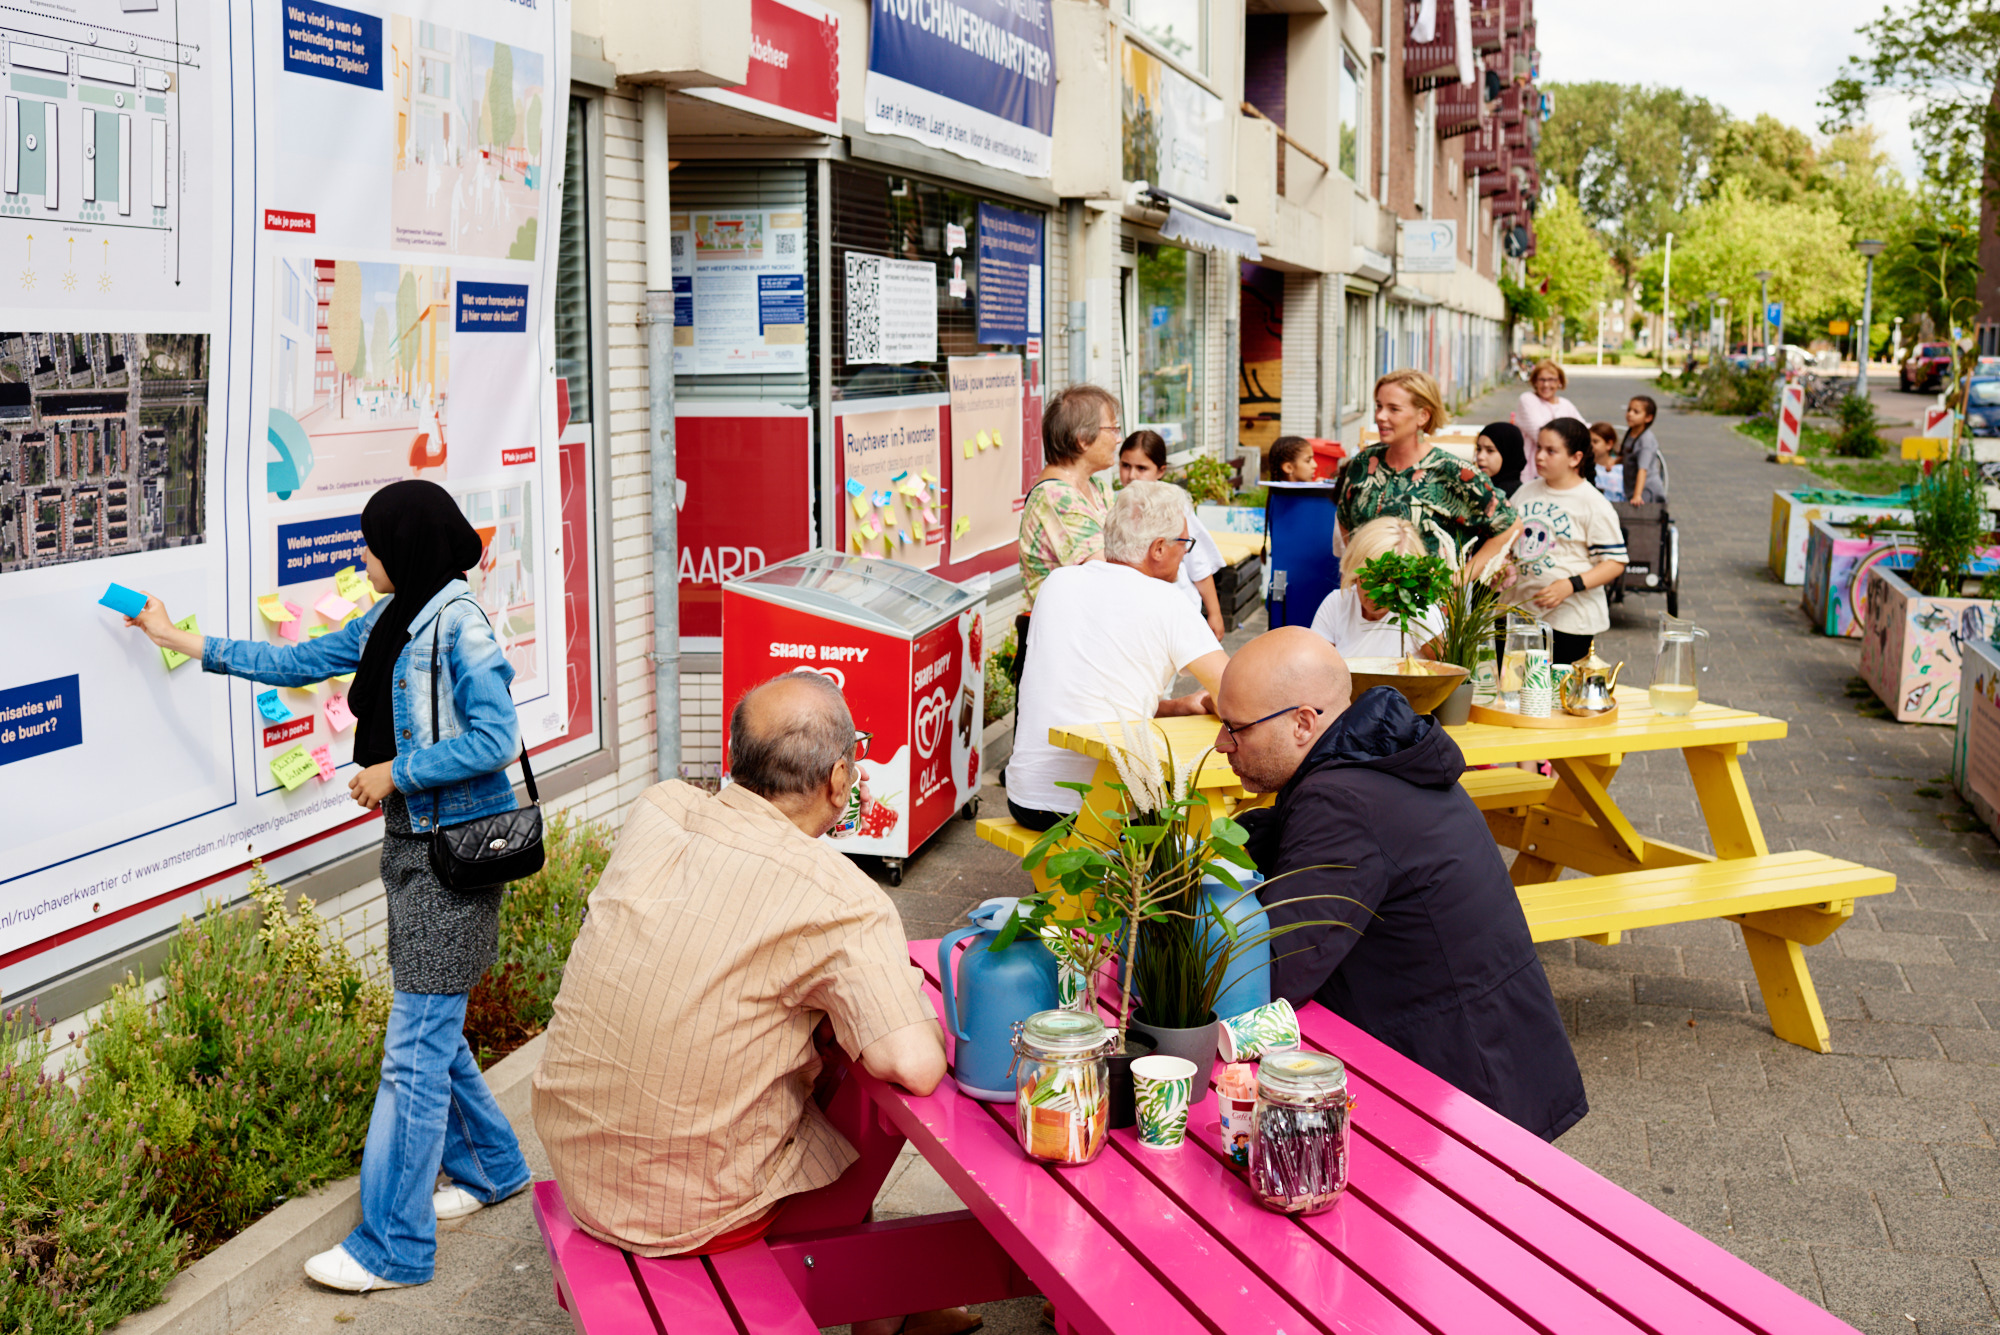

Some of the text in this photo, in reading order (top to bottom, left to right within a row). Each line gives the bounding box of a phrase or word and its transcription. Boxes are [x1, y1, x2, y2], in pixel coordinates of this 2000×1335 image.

[288, 6, 363, 37] Wat vind je van de
[288, 29, 365, 56] verbinding met het
[289, 45, 335, 67] Lambertus
[875, 97, 894, 121] Laat
[895, 103, 903, 127] je
[904, 105, 928, 132] horen.
[929, 114, 946, 136] Laat
[946, 119, 953, 142] je
[953, 123, 969, 144] zien.
[970, 128, 984, 147] Voor
[267, 214, 282, 226] Plak
[462, 293, 475, 306] Wat
[475, 296, 488, 306] voor
[469, 309, 480, 321] hier
[480, 312, 493, 322] voor
[493, 310, 501, 322] de
[953, 373, 968, 391] Maak
[969, 372, 984, 394] jouw
[847, 424, 935, 456] Ruychaver in 3 woorden
[1518, 501, 1571, 539] ICKEY
[287, 529, 364, 550] Welke voorzieninge
[287, 557, 303, 568] zou
[303, 553, 312, 568] je
[313, 551, 329, 564] hier
[330, 548, 352, 564] graag
[46, 694, 62, 711] wil
[1, 717, 58, 744] de buurt?
[266, 721, 310, 742] Plak je post-it
[121, 868, 133, 885] of
[135, 791, 353, 879] www.amsterdam.nl/projecten/geuzenveld/deelpro
